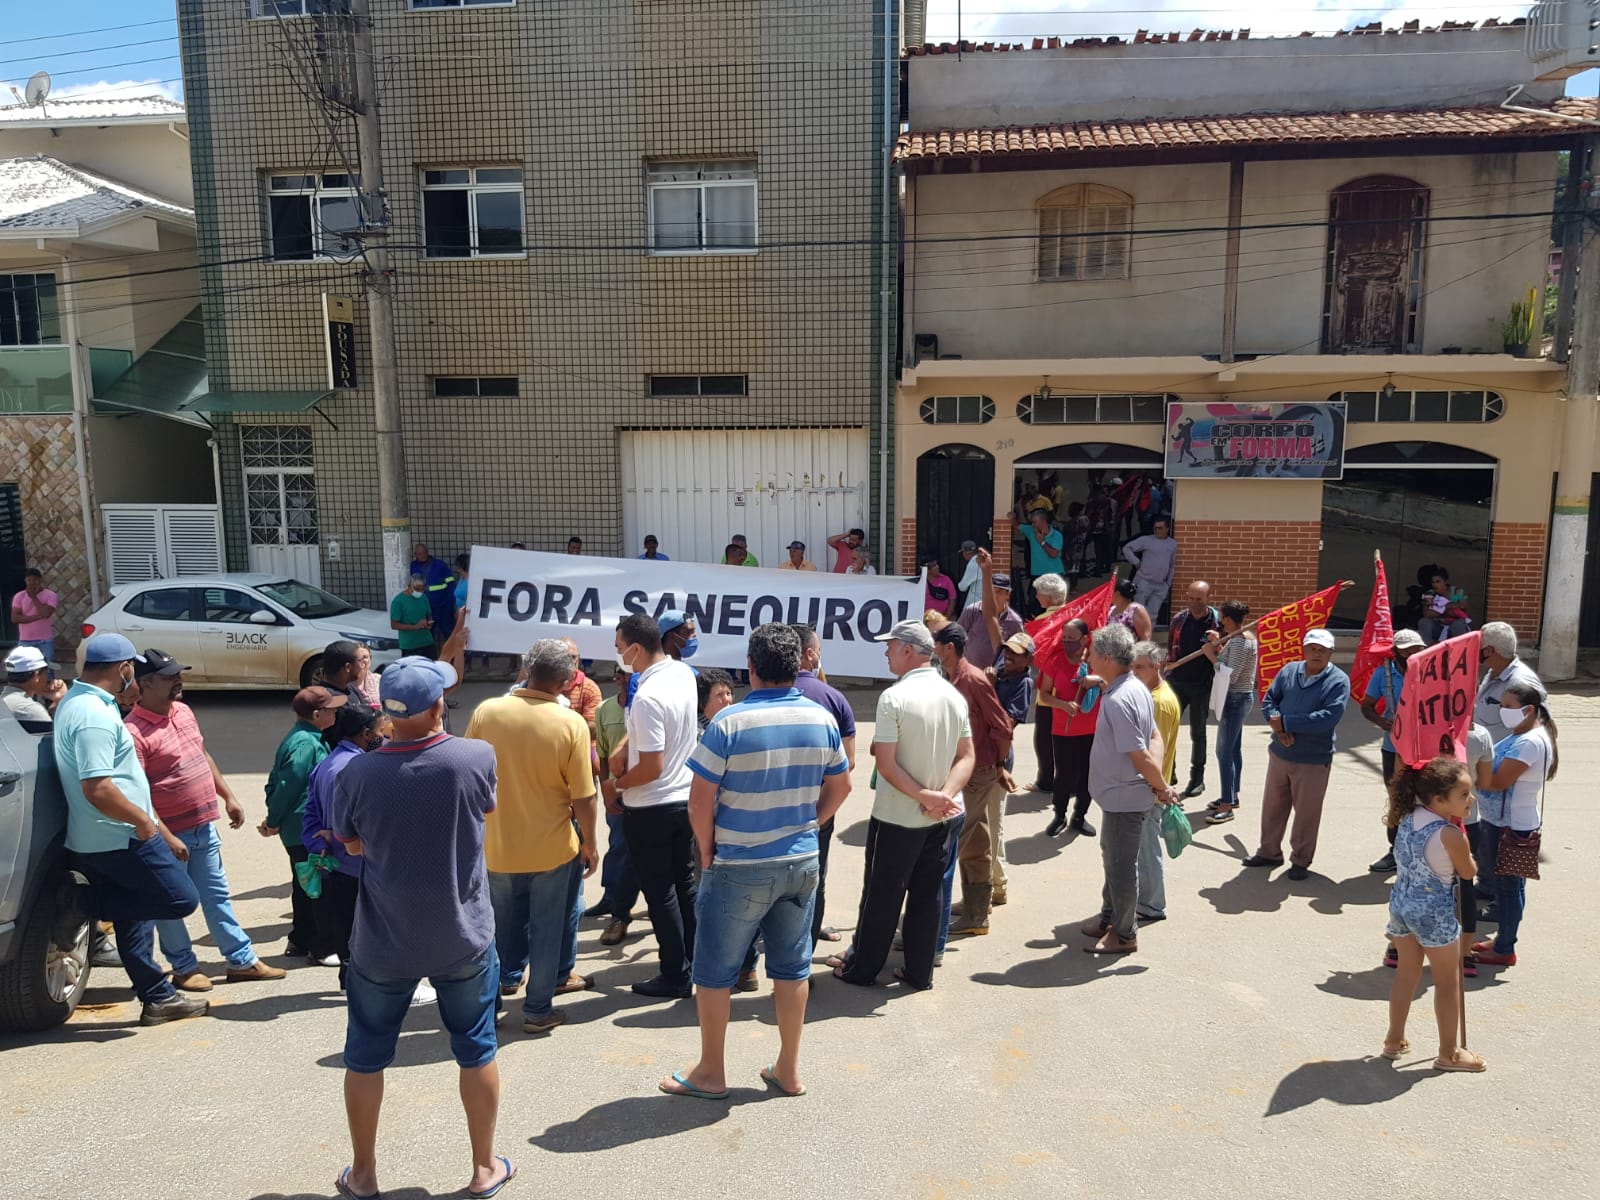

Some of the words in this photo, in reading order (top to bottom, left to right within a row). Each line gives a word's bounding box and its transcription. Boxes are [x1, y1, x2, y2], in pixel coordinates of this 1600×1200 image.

[337, 324, 351, 388] POUSADA
[1210, 424, 1315, 438] CORPO
[1211, 437, 1229, 447] EM
[1229, 437, 1313, 460] FORMA
[478, 577, 602, 627] FORA
[1281, 602, 1300, 623] DE
[226, 632, 268, 645] BLACK
[1283, 628, 1303, 665] DEFE
[1258, 616, 1282, 693] POPULA
